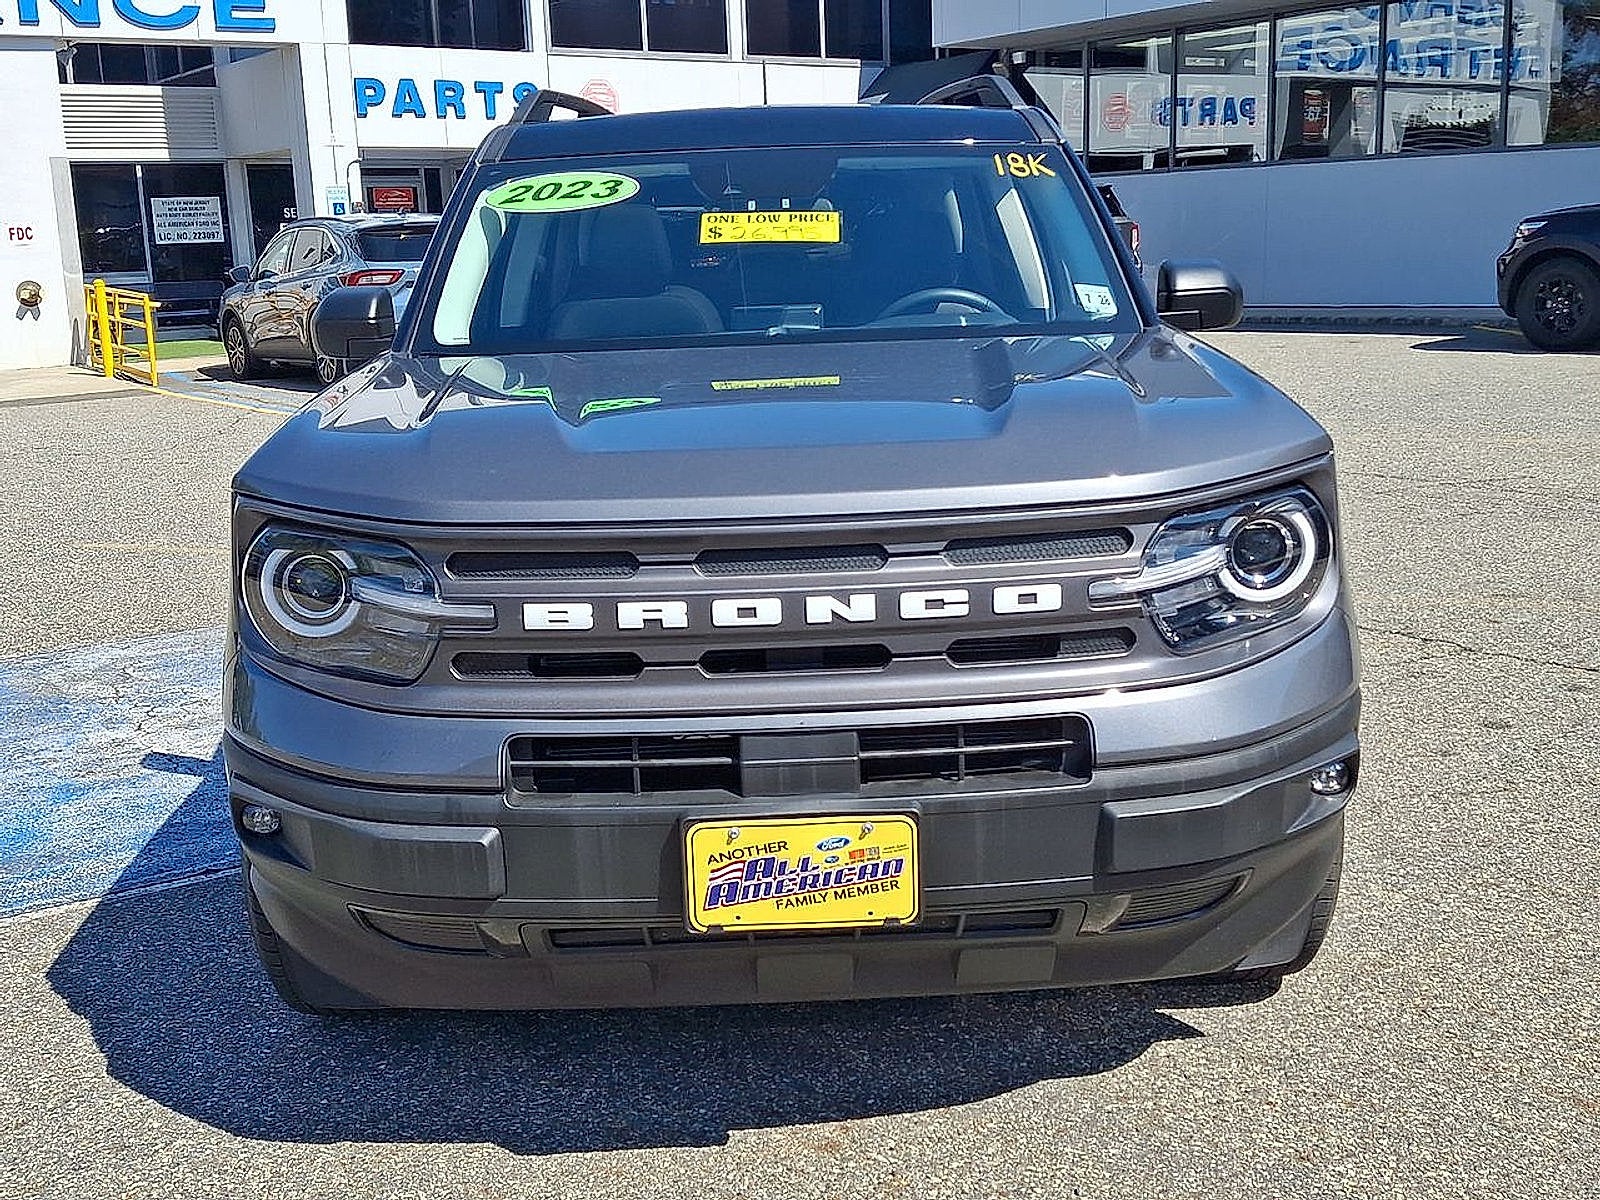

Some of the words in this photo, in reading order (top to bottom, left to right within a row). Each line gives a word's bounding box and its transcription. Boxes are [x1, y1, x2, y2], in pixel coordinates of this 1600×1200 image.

[0, 0, 275, 32] NCE
[994, 153, 1056, 177] 18K
[498, 180, 624, 205] 2023
[707, 214, 740, 224] ONE
[747, 214, 781, 223] LOW
[789, 213, 835, 223] PRICE
[9, 227, 34, 241] FDC
[707, 226, 723, 240] $
[522, 583, 1063, 630] BRONCO
[707, 840, 789, 866] ANOTHER
[818, 838, 850, 851] Ford
[744, 856, 820, 882] ALL
[704, 857, 905, 911] AMERICAN
[775, 892, 830, 910] FAMILY
[833, 880, 901, 900] MEMBER
